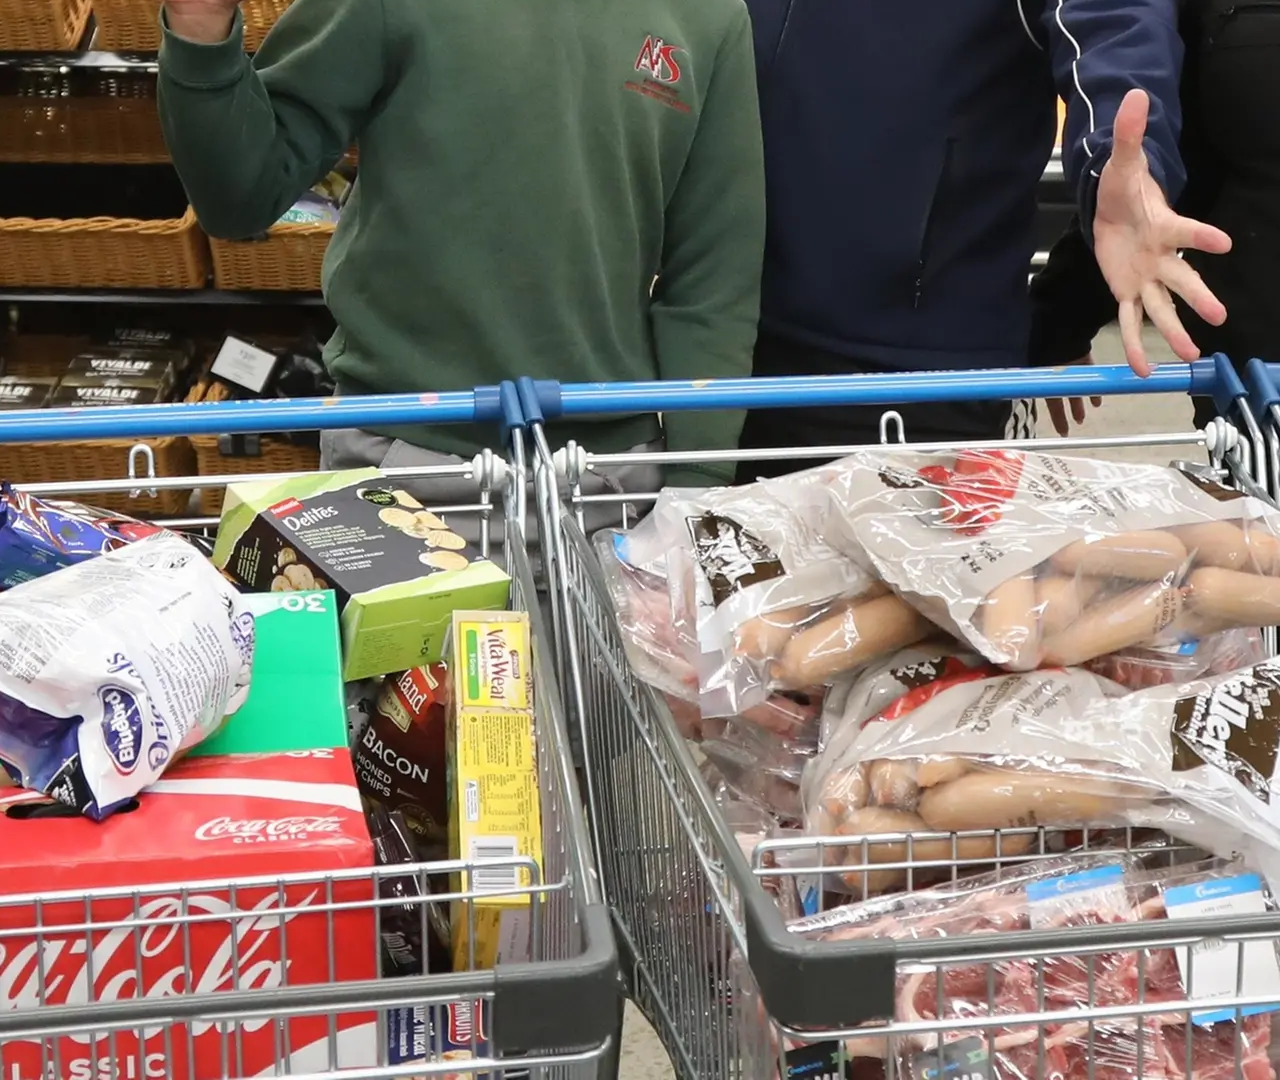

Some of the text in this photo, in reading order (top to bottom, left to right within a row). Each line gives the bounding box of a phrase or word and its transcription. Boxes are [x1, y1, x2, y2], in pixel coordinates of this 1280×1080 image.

[89, 358, 153, 371] VIVALDI
[76, 388, 141, 400] VIVALDI
[282, 504, 339, 531] Delites
[362, 726, 429, 784] BACON
[361, 770, 392, 798] CHIPS
[195, 815, 342, 844] Coca-Cola
[231, 831, 308, 844] CLASSIC
